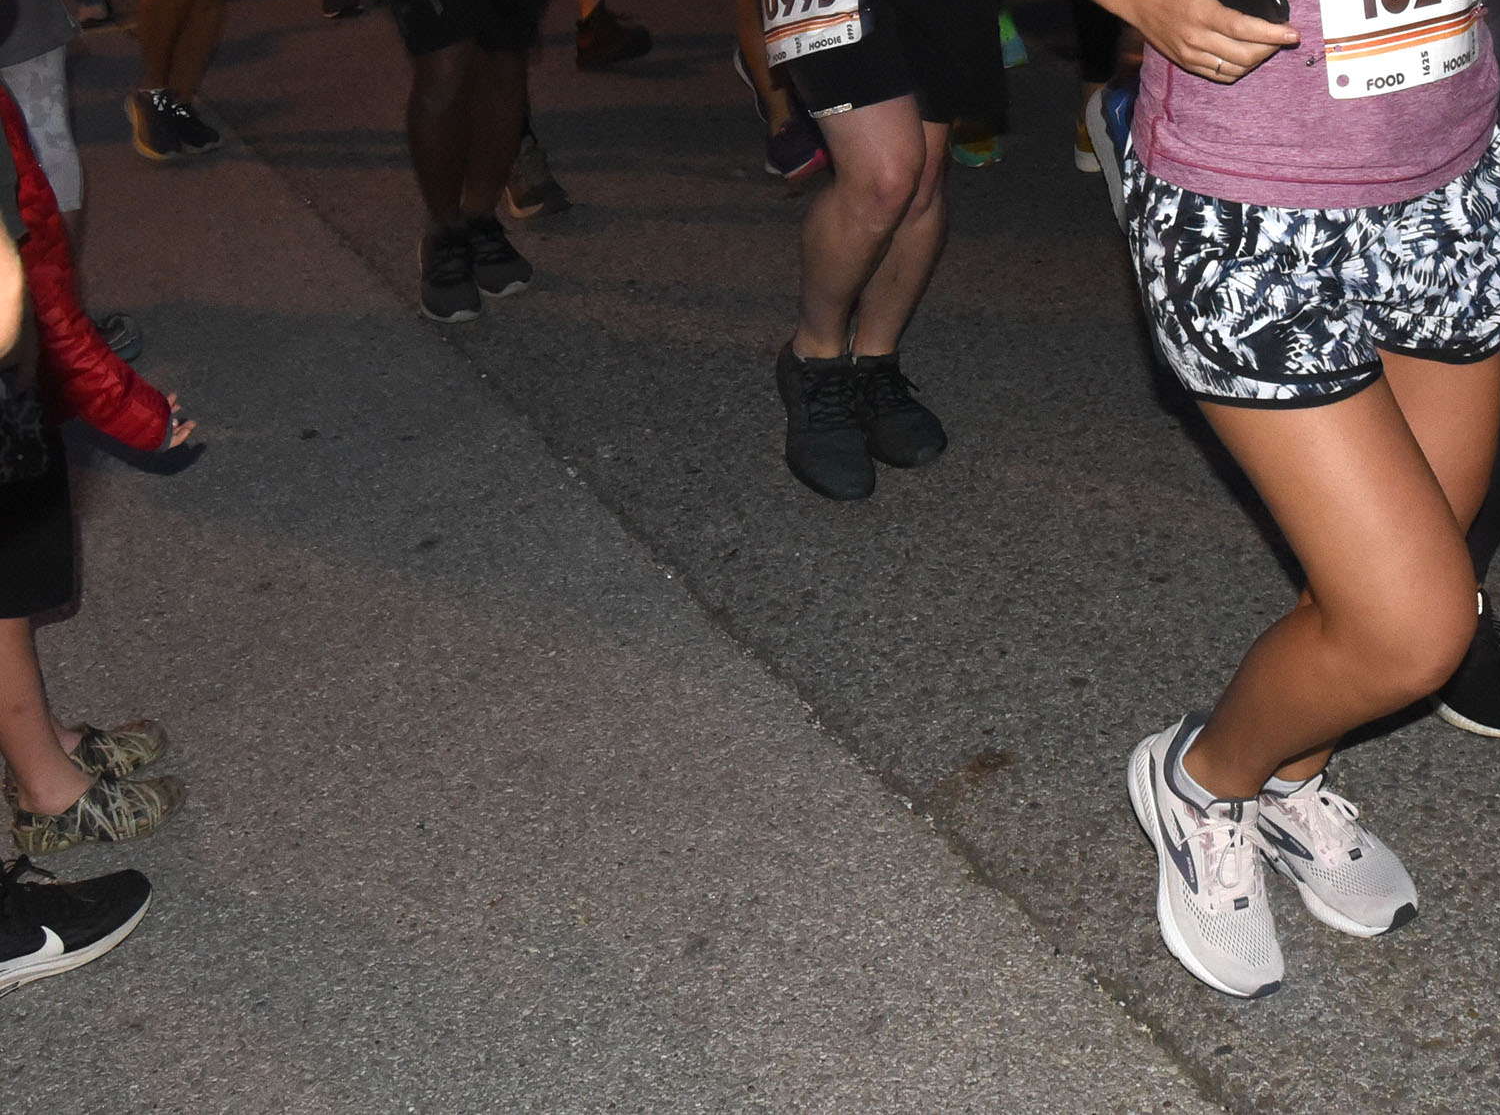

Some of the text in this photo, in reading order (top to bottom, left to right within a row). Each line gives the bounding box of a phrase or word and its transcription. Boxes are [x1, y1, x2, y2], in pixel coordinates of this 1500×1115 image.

[808, 35, 843, 51] HOODIE
[1420, 50, 1431, 76] 1625
[1366, 72, 1406, 92] FOOD
